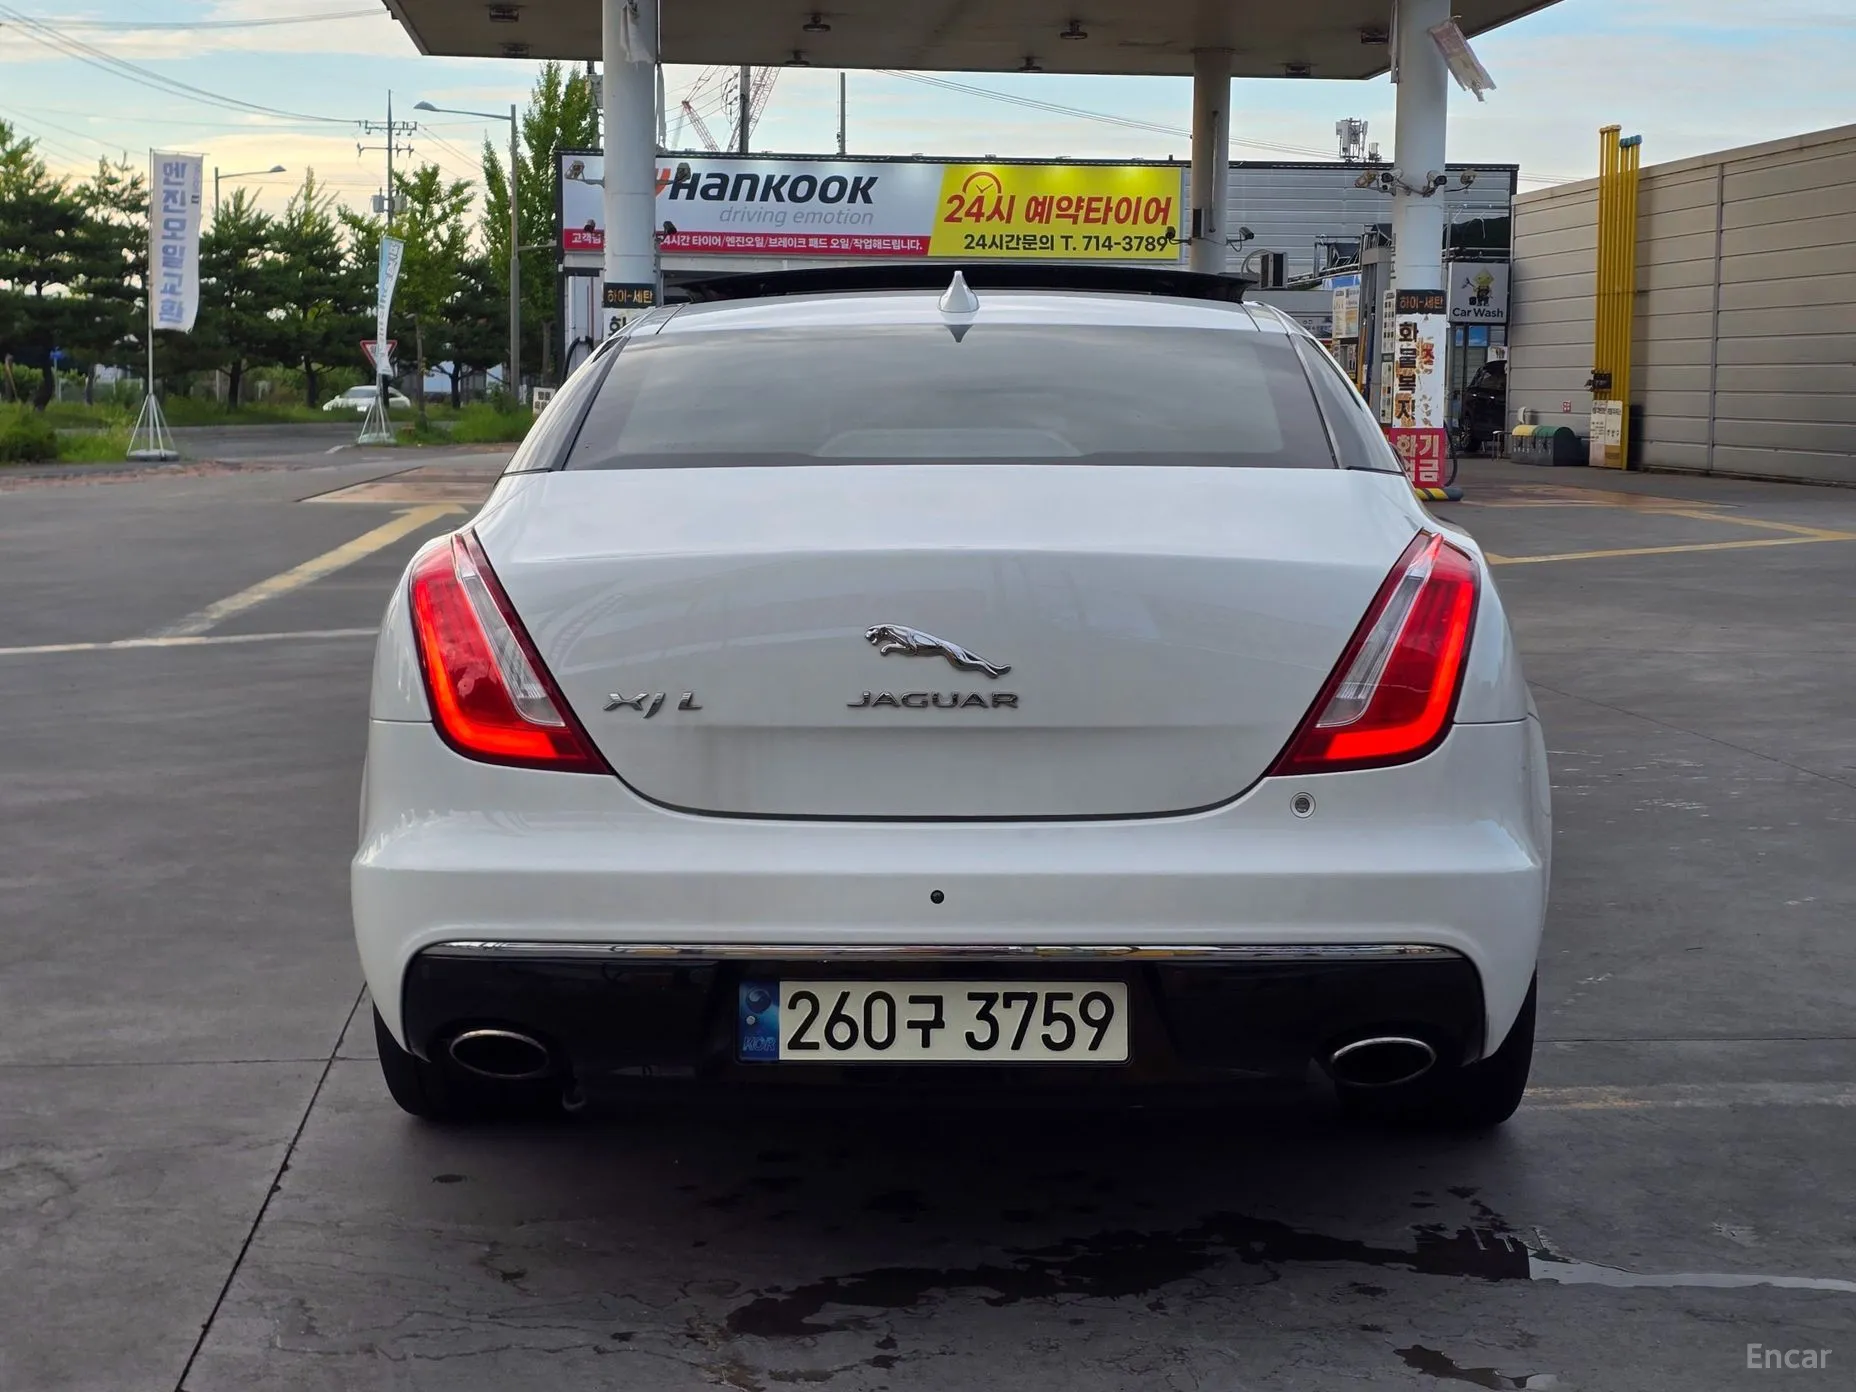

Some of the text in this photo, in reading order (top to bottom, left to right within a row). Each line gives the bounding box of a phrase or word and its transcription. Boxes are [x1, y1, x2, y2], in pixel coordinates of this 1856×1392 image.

[720, 206, 874, 228] driving emotion
[944, 194, 1171, 226] 24시 예약타이어
[808, 237, 829, 249] 패드
[963, 234, 1167, 252] 24시간문의 T. 714-3789
[1452, 307, 1504, 318] Car Wash
[846, 689, 1020, 710] JAGUAR
[786, 989, 1115, 1052] 260구 3759
[742, 1036, 777, 1052] KOR
